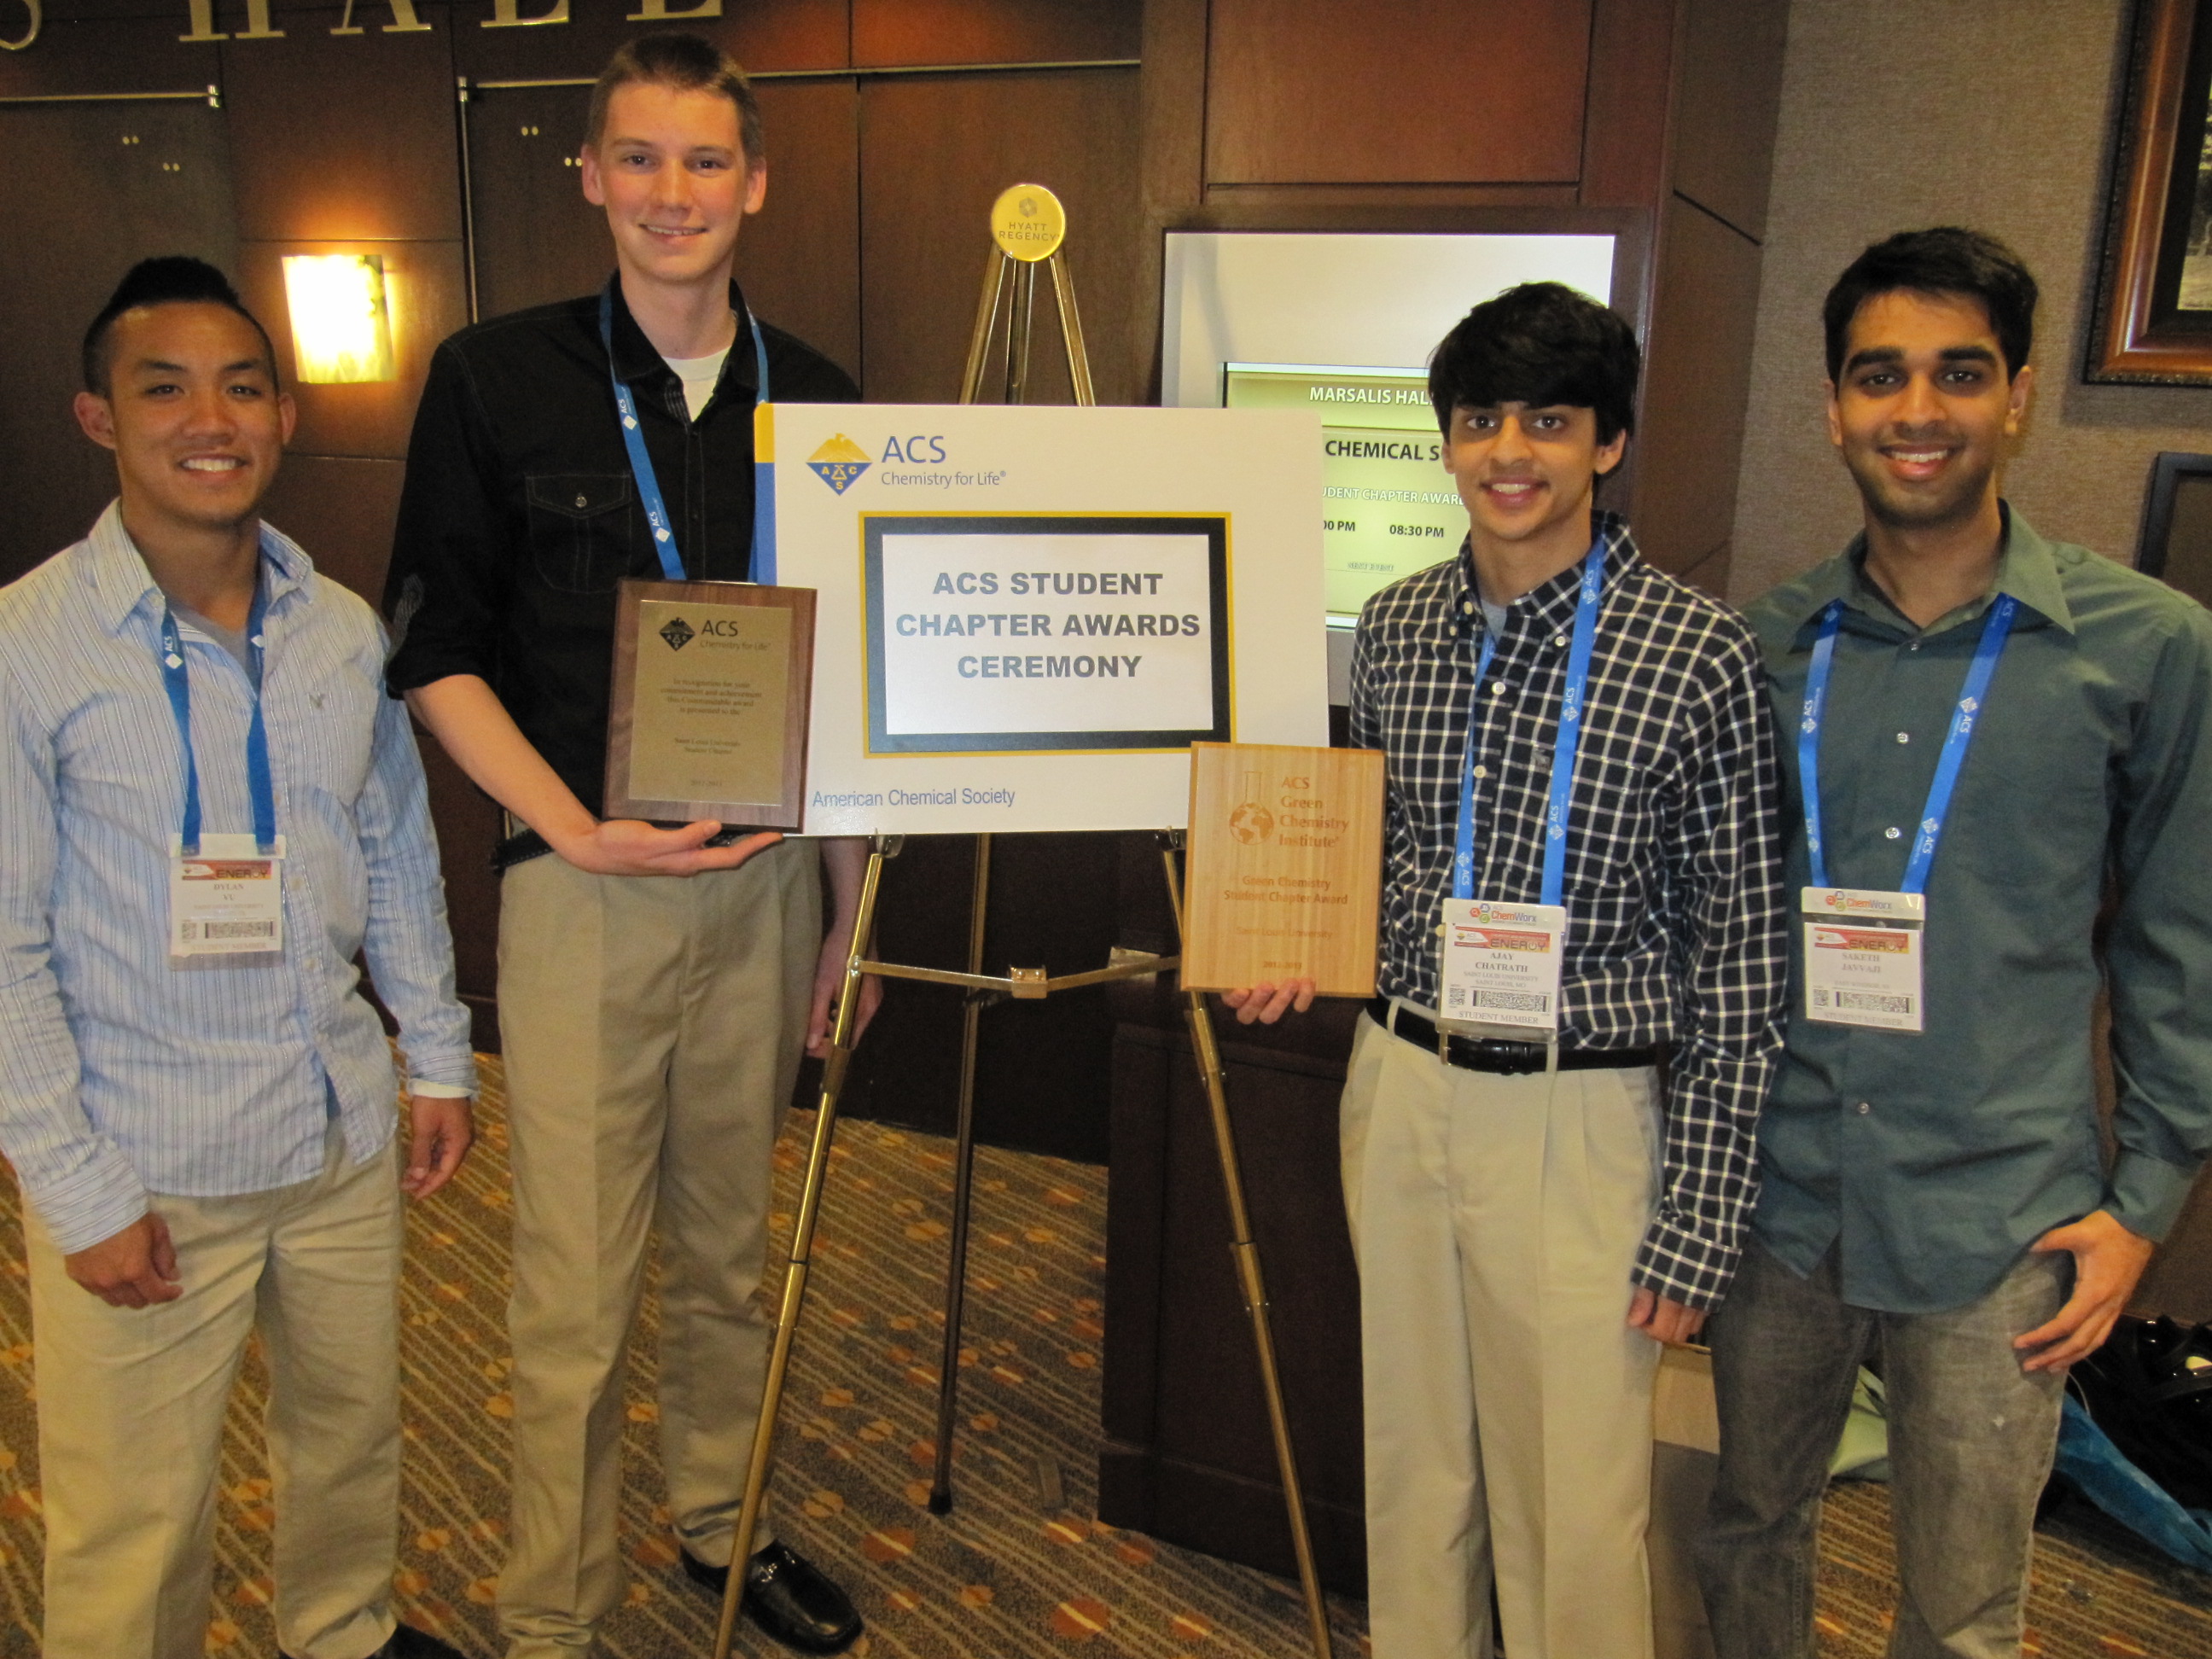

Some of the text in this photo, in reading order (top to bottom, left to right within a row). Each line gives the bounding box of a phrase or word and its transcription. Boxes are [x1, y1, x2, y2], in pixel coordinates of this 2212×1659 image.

[1009, 222, 1047, 230] HYATT
[998, 231, 1057, 242] REGENCY
[1309, 387, 1433, 405] MARSALIS HAL
[618, 399, 627, 414] ACS
[881, 435, 947, 464] ACS
[1324, 439, 1423, 461] CHEMICAL
[881, 471, 952, 489] Chemistry
[955, 471, 974, 486] for
[1362, 488, 1417, 503] CHAPTER
[649, 511, 660, 527] ACS
[1337, 521, 1356, 532] PM
[1389, 524, 1445, 538] 08:30 PM
[932, 572, 1163, 596] ACS STUDENT
[701, 620, 739, 637] ACS
[896, 614, 1201, 637] CHAPTER AWARDS
[957, 655, 1143, 678] CEREMONY
[1565, 687, 1575, 704] ACS
[1804, 700, 1813, 717] ACS
[1959, 714, 1973, 734] ACS
[1281, 777, 1310, 789] ACS
[812, 787, 1016, 807] American Chemical Society
[1281, 795, 1323, 809] Green
[1550, 805, 1559, 822] ACS
[1279, 814, 1349, 834] Chemistry
[1923, 835, 1935, 854] ACS
[1243, 876, 1331, 891] Green Chemistry
[1225, 890, 1348, 905] Student Chapter Award
[1492, 910, 1537, 923] ChemWorx
[1490, 952, 1514, 961] AJAY
[1475, 962, 1528, 973] CHATRATH
[1459, 1010, 1498, 1022] STUDENT
[1500, 1015, 1539, 1024] MEMBER
